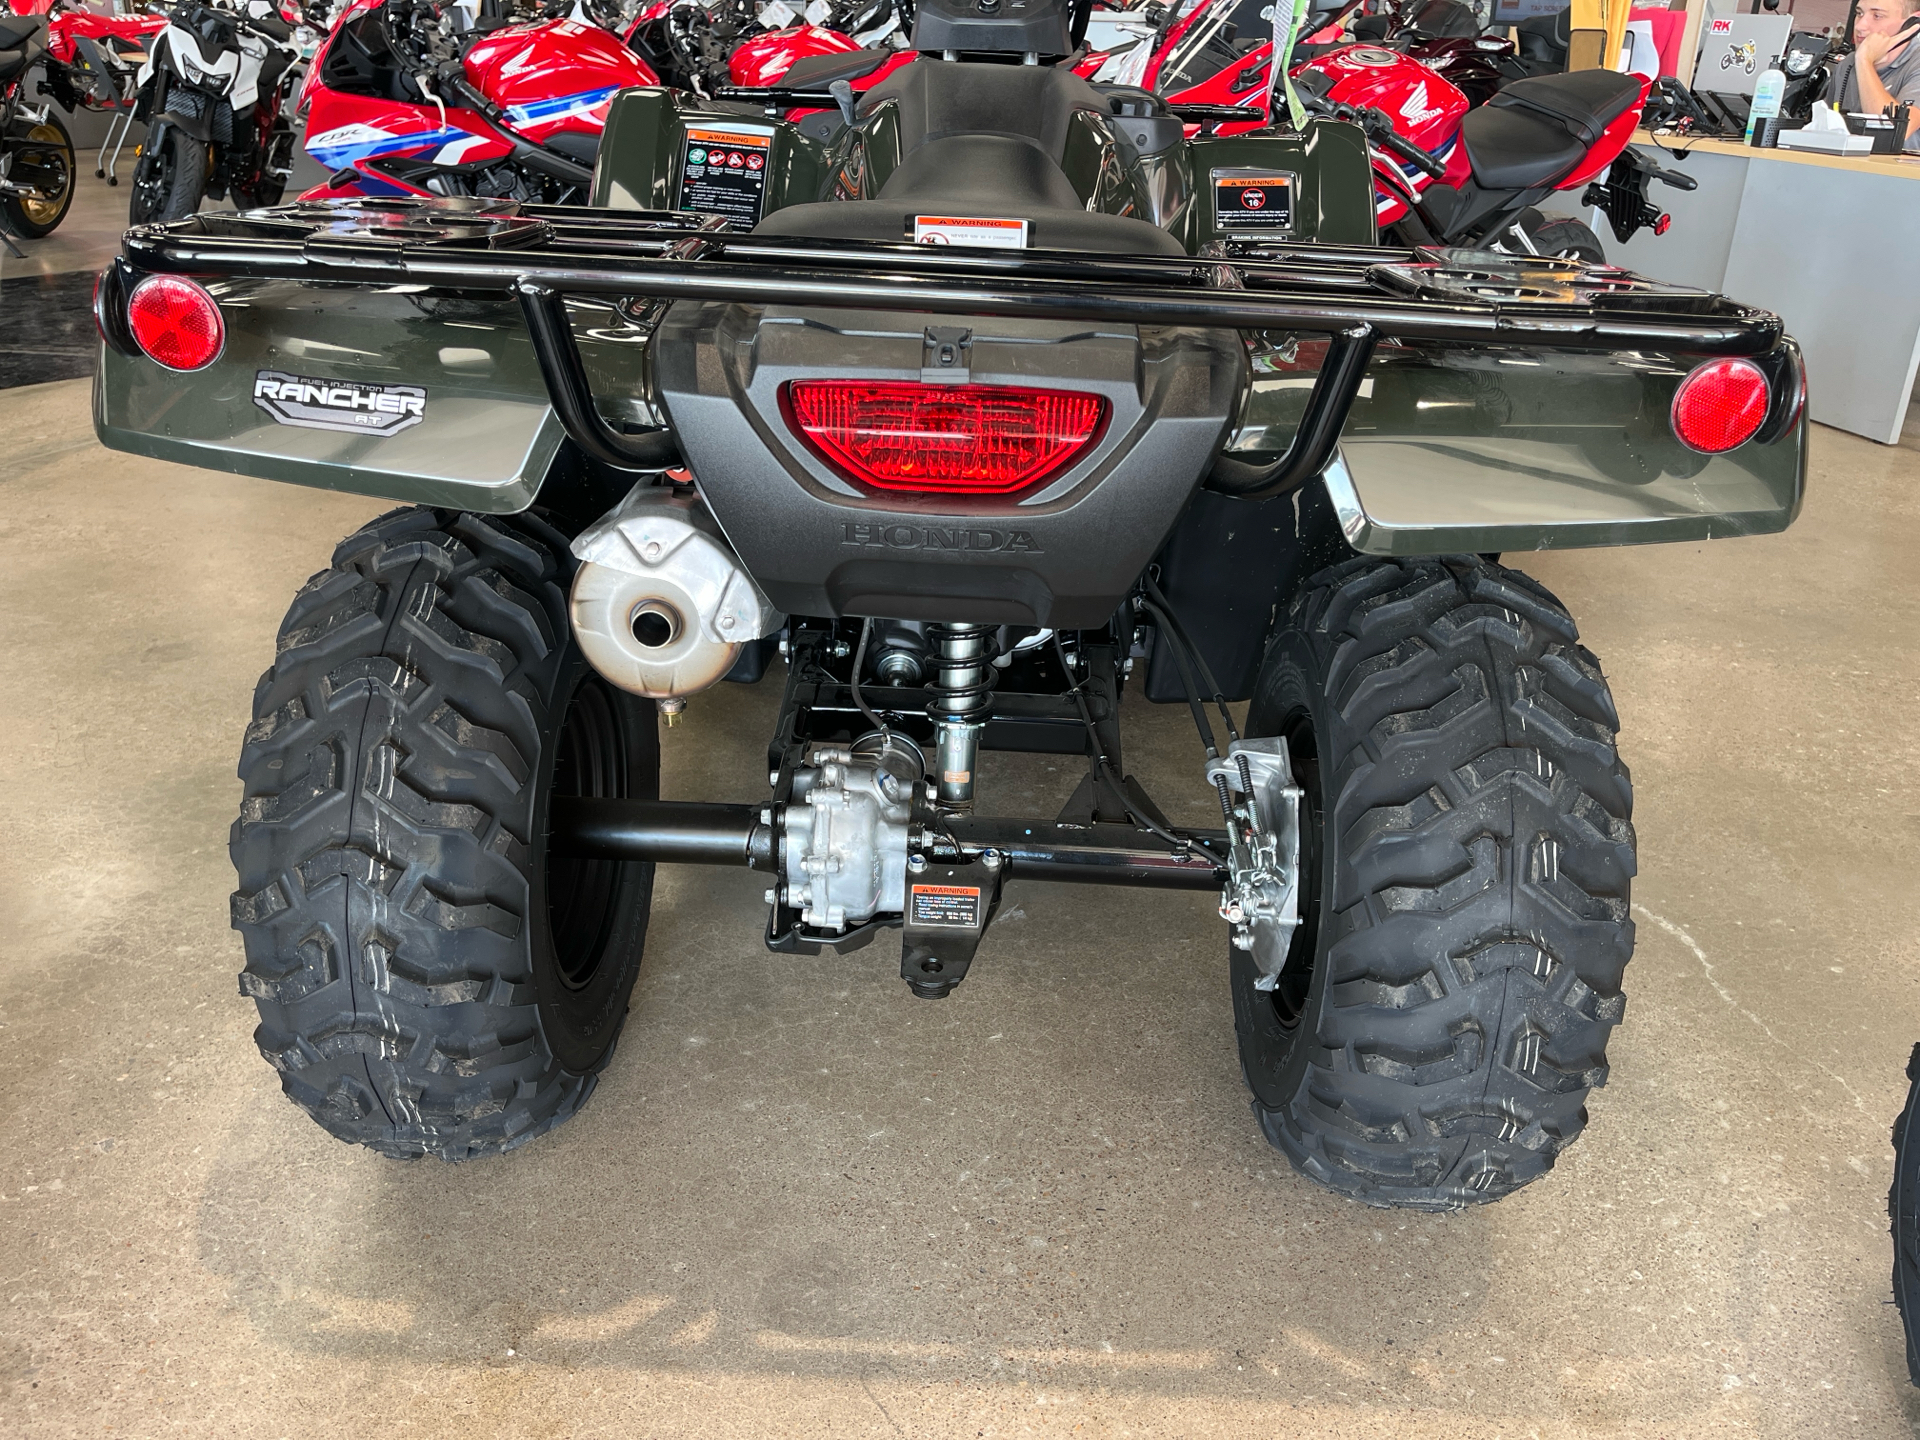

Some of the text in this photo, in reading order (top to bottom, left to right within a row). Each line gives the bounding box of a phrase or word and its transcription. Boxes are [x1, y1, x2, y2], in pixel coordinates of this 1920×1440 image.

[1712, 20, 1732, 32] RK
[500, 64, 537, 80] HONDA
[1406, 107, 1444, 127] HONDA
[713, 134, 749, 144] WARNING
[1248, 199, 1259, 207] 16
[300, 378, 383, 392] FUEL INJECTION
[254, 380, 425, 416] RANCHER
[354, 414, 382, 425] AT
[841, 522, 1045, 554] HONDA
[930, 887, 968, 895] WARNING
